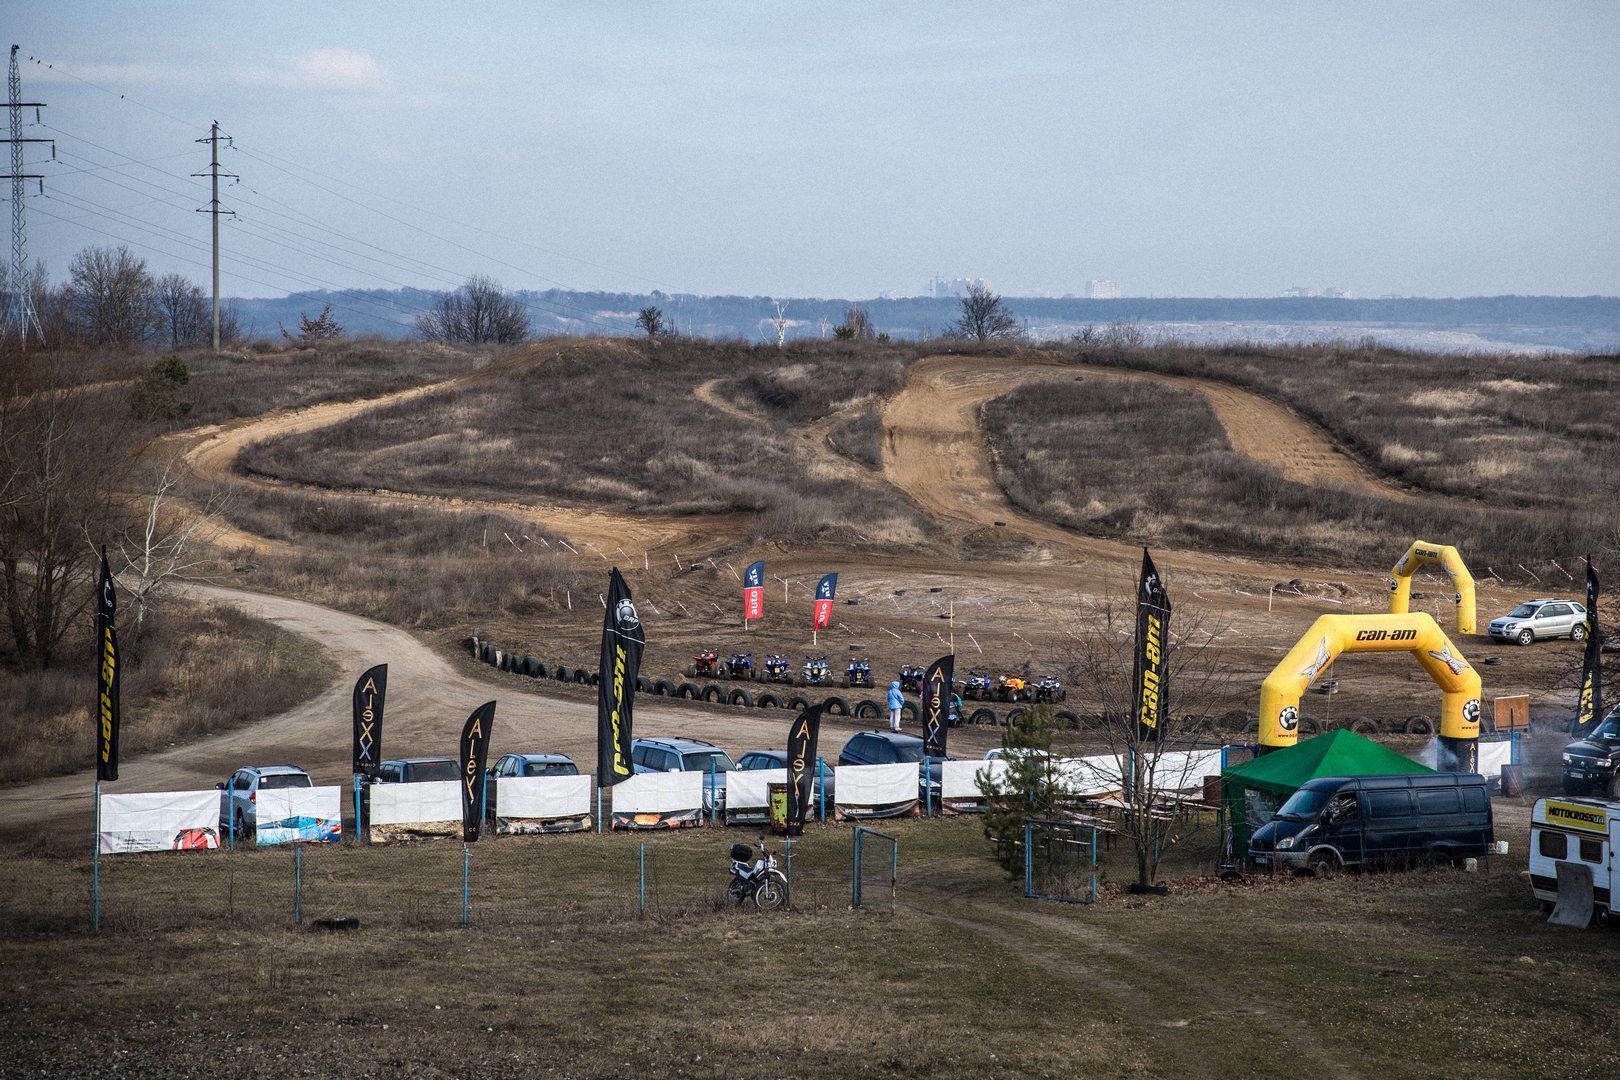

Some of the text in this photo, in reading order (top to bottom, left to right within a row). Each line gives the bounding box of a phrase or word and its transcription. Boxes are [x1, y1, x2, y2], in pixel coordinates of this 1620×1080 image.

[750, 591, 758, 615] auto
[1356, 629, 1417, 641] can-am
[1141, 614, 1161, 729] can-am
